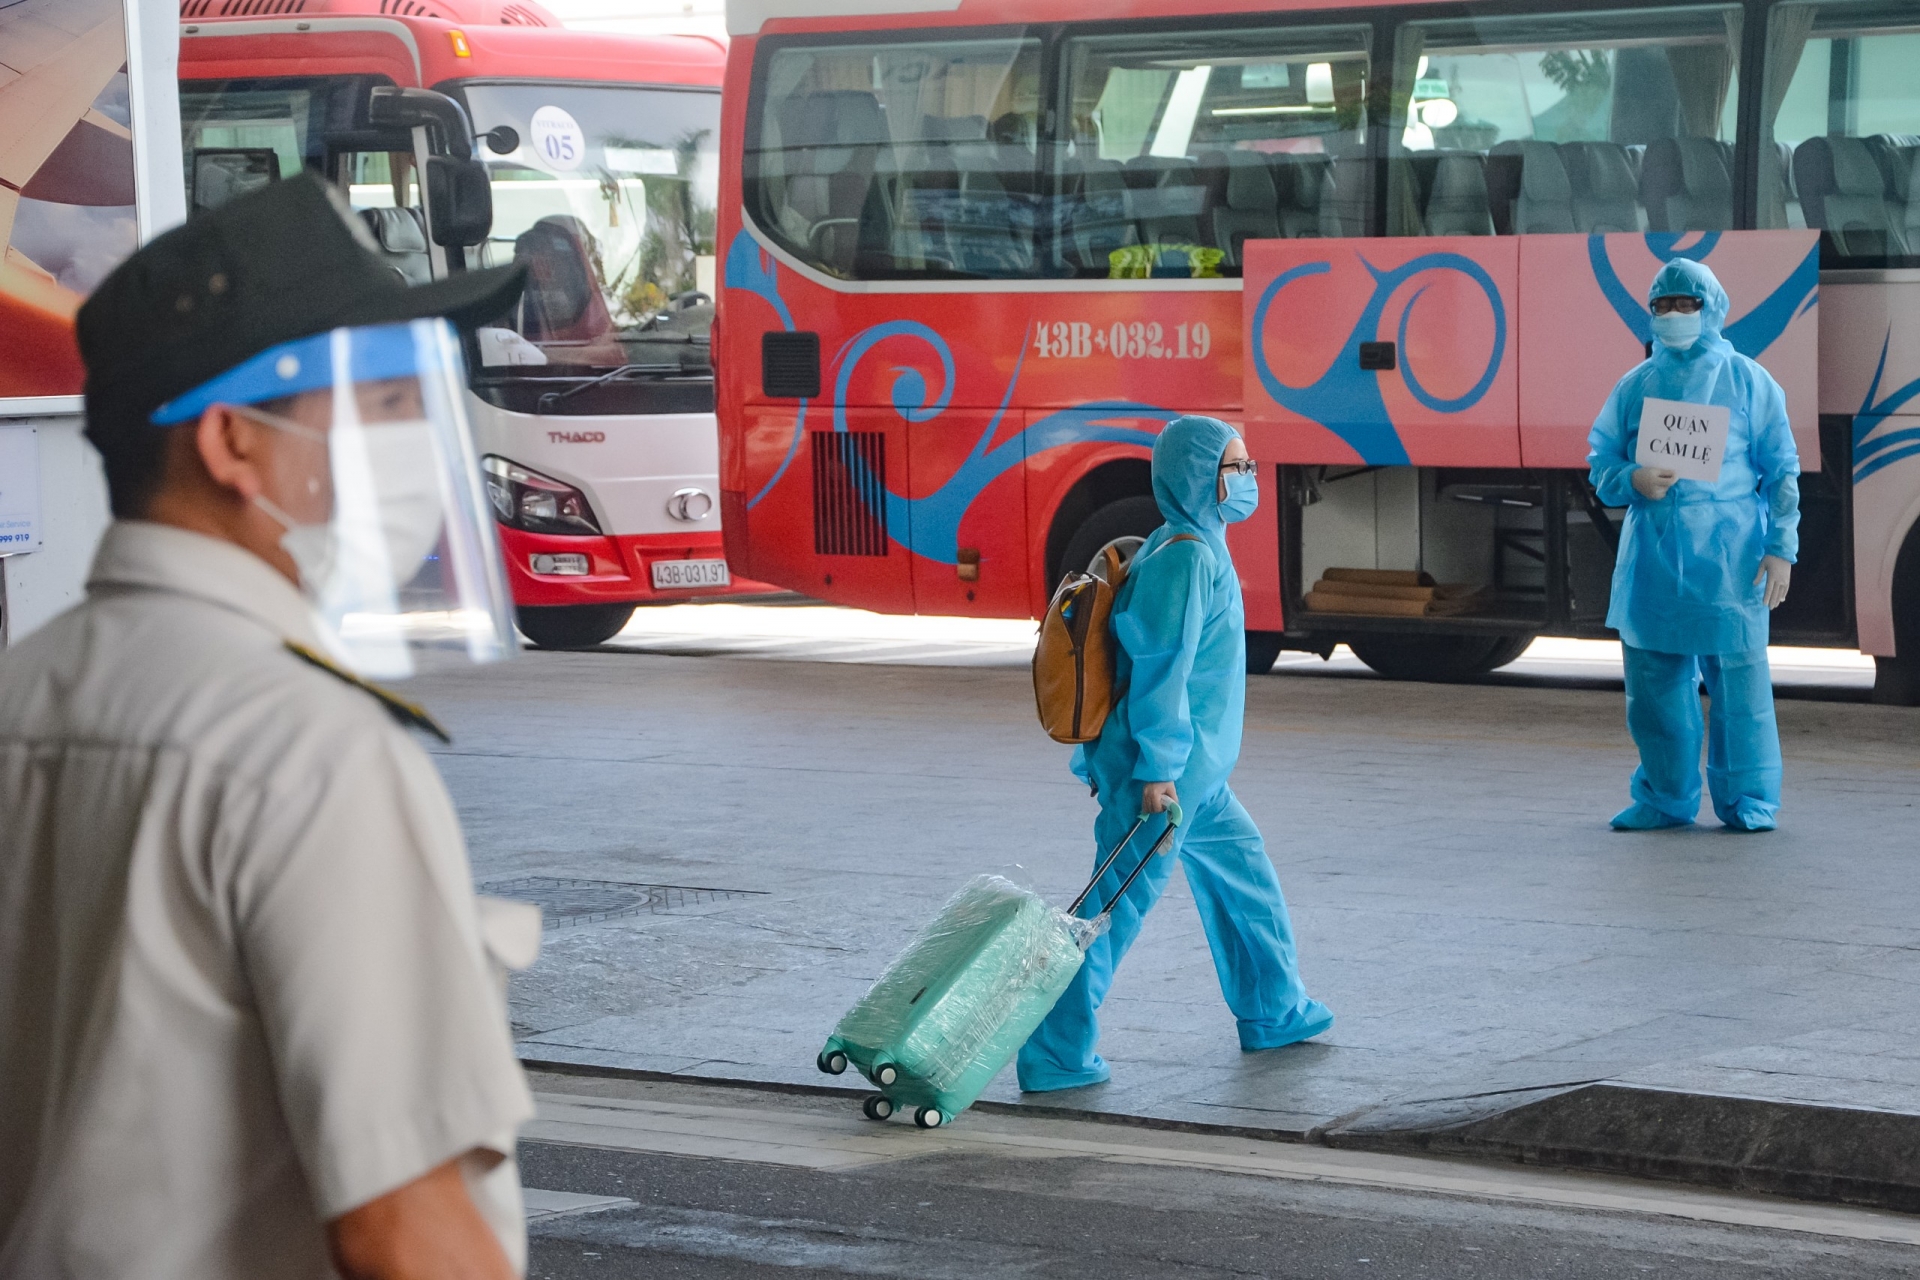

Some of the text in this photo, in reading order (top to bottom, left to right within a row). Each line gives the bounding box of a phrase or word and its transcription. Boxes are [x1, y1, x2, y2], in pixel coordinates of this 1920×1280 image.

[545, 134, 574, 160] 05
[1663, 413, 1709, 435] QUẬN
[547, 432, 605, 443] THACO
[15, 533, 29, 542] 919
